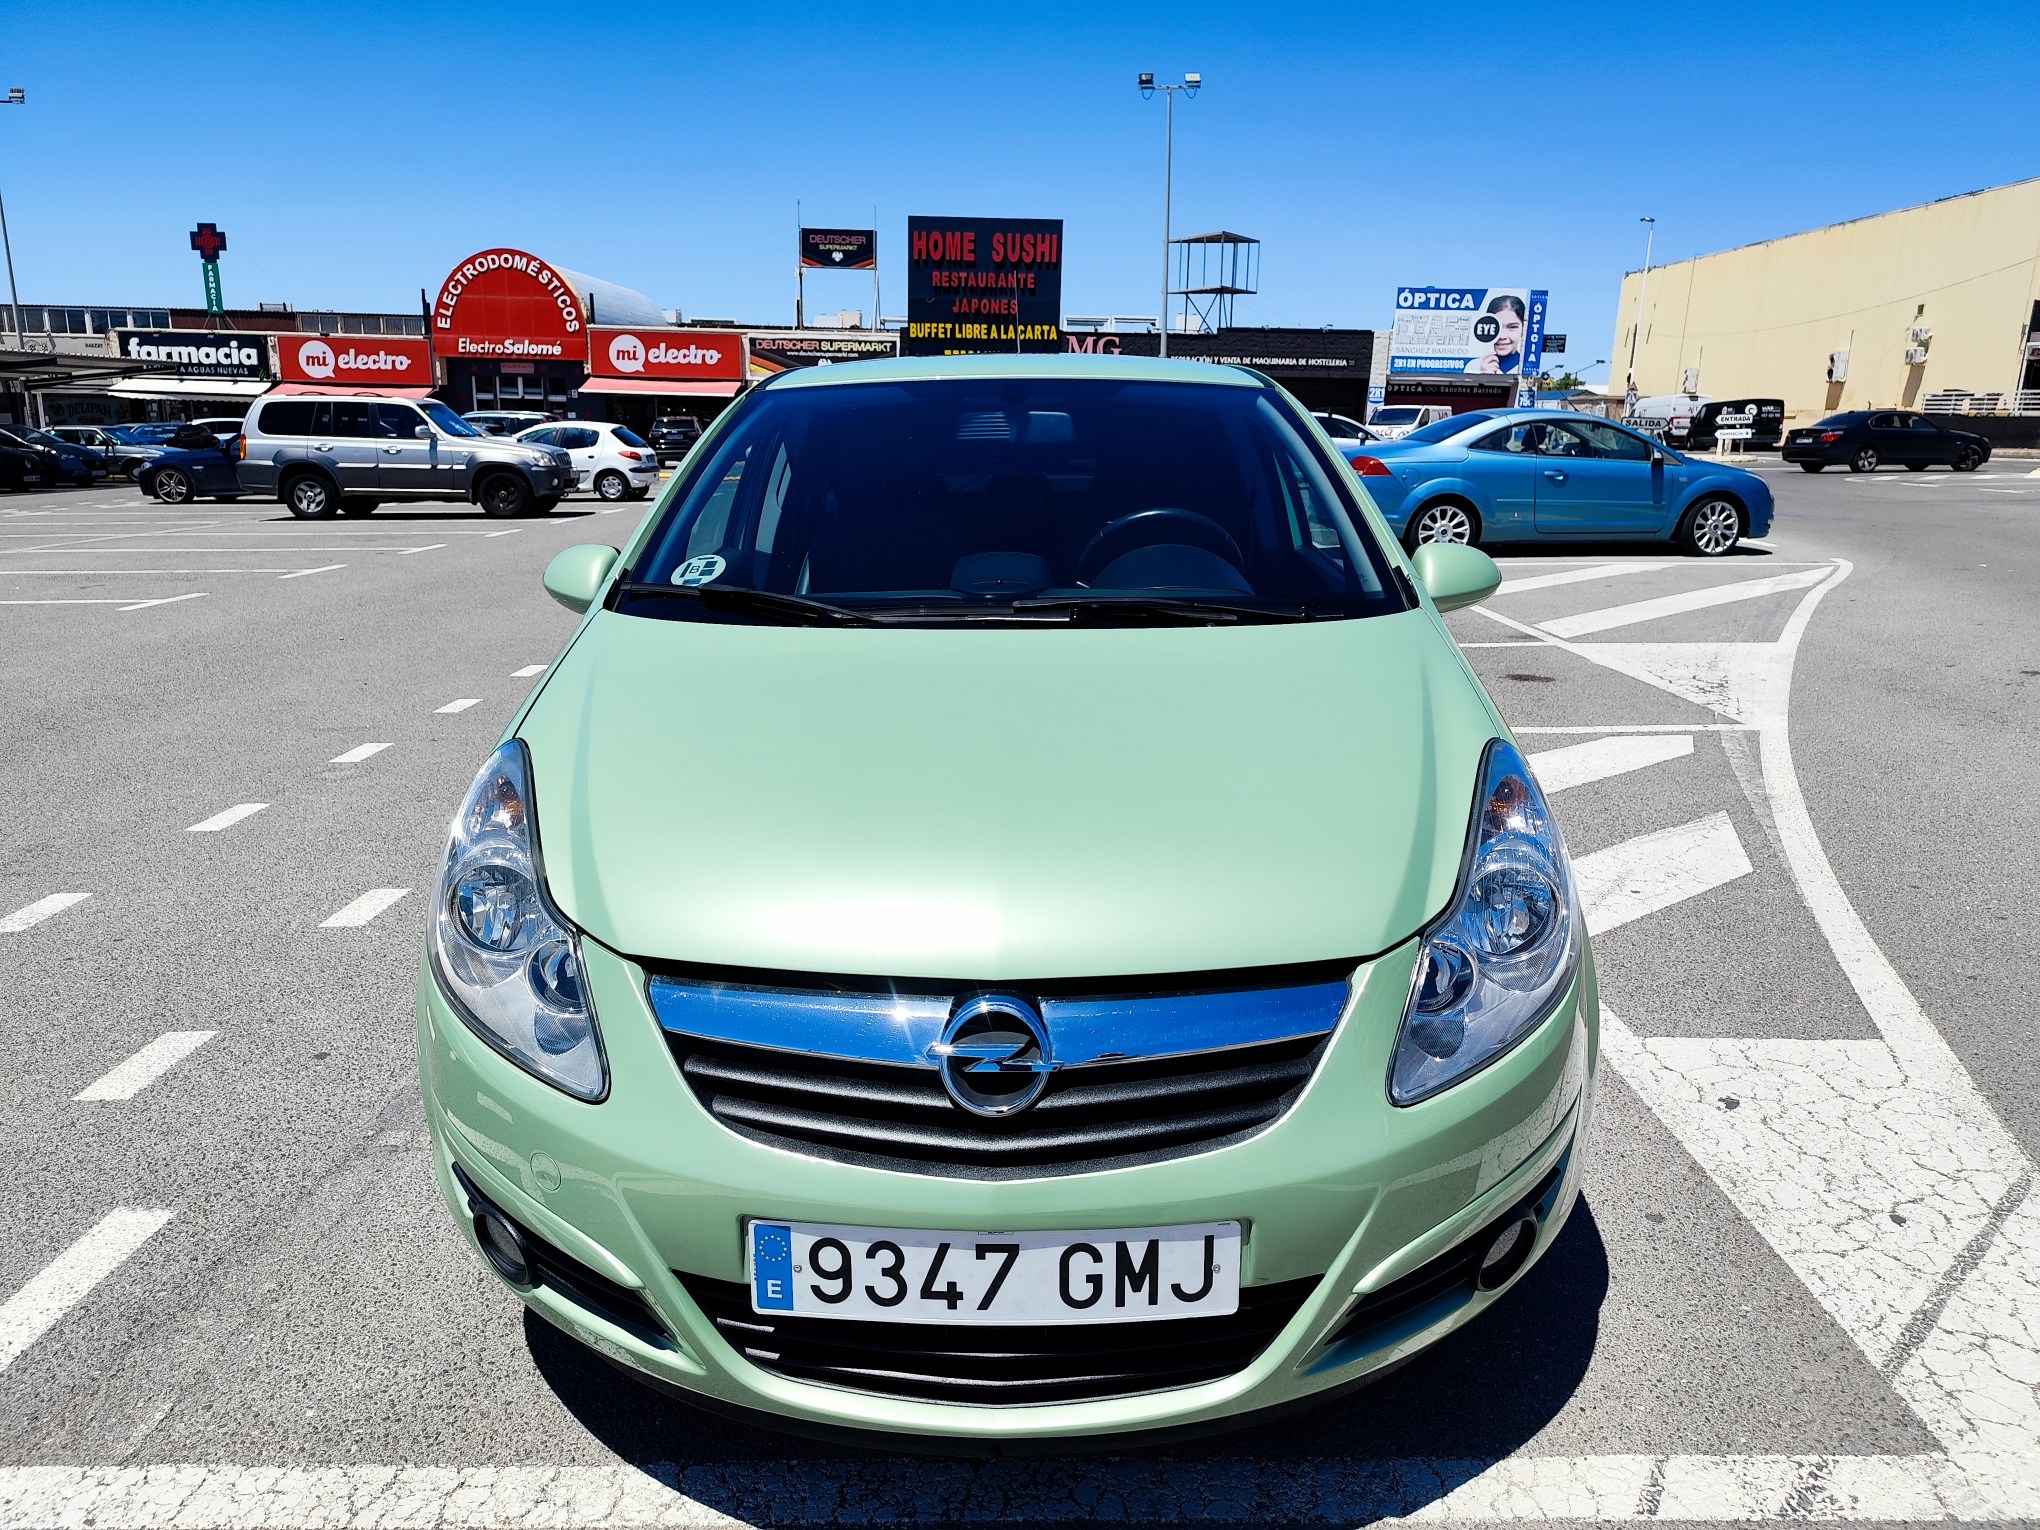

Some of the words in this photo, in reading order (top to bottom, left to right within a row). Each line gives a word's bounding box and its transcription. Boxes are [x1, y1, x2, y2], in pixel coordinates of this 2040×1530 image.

[809, 234, 867, 244] DEUTSCHER
[913, 231, 975, 261] HOME
[991, 233, 1058, 263] SUSHI
[207, 264, 218, 312] FARMACIA
[932, 271, 1035, 288] RESTAURANTE
[437, 253, 580, 333] ELECTRODOMÉSTICOS
[1398, 289, 1475, 309] ÓPTICA
[952, 299, 1018, 314] JAPONES
[909, 322, 952, 338] BUFFET
[955, 323, 988, 339] LIBRE
[990, 324, 998, 339] A
[1000, 324, 1016, 340] LA
[1018, 325, 1058, 340] CARTA
[1476, 323, 1497, 336] EYE
[128, 337, 259, 365] farmacia
[458, 338, 562, 355] ElectroSalomé
[616, 345, 639, 361] mi
[647, 342, 722, 365] electro
[755, 339, 820, 350] DEUTSCHER
[821, 341, 892, 352] SUPERMARKT
[1431, 346, 1469, 355] BARREDO
[306, 351, 329, 367] mi
[337, 348, 411, 371] electro
[1219, 356, 1241, 364] VENTA
[1242, 356, 1251, 364] DE
[1252, 357, 1297, 366] MAQUINARIA
[1299, 358, 1307, 366] DE
[187, 366, 215, 374] AGUAS
[217, 367, 249, 375] NUEVAS
[1625, 419, 1661, 427] SALIDA
[689, 565, 700, 573] B
[808, 1236, 1021, 1311] 9347
[1058, 1234, 1215, 1310] GMJ
[767, 1279, 783, 1298] E
